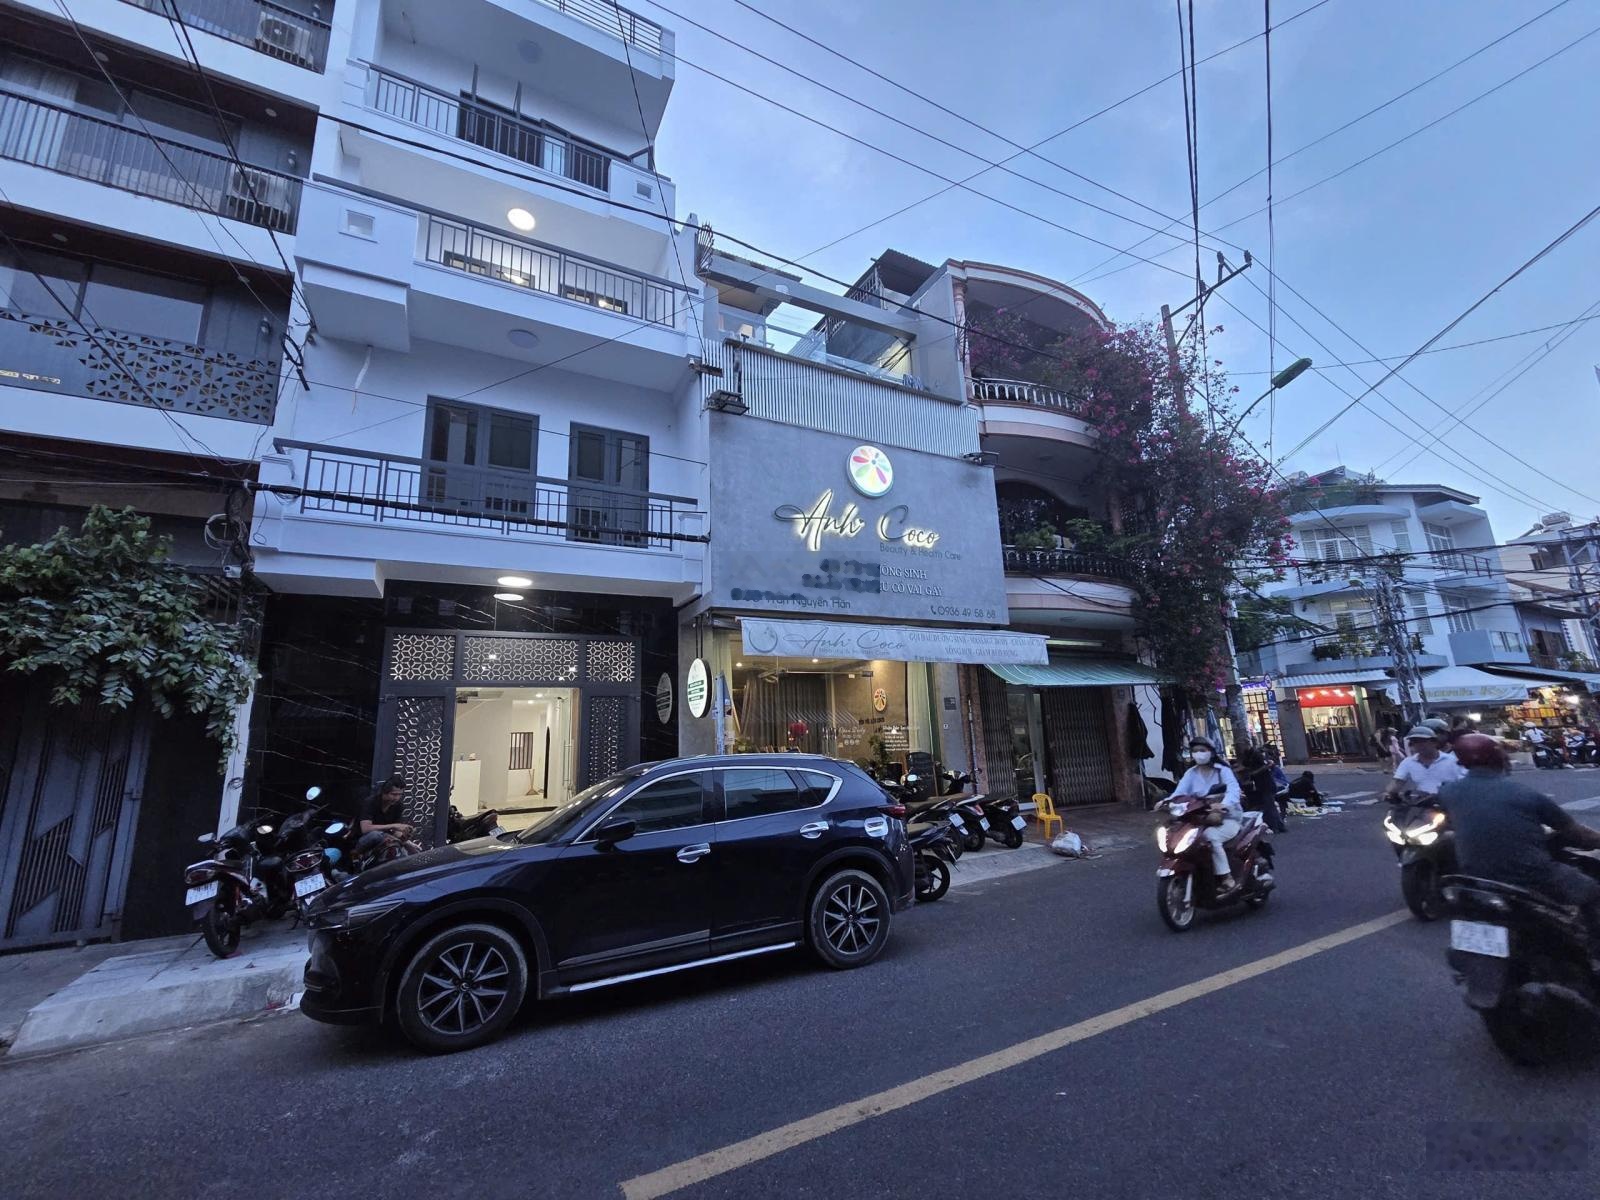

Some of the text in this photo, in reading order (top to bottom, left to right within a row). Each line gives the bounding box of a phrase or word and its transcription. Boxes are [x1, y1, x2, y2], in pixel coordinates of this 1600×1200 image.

[774, 490, 939, 550] Anh Coco
[880, 542, 908, 555] Beauty
[945, 550, 961, 560] Care
[904, 567, 928, 580] SINH
[938, 605, 960, 616] 0936
[962, 607, 971, 617] 49
[974, 608, 984, 617] 58
[857, 629, 906, 649] Coco
